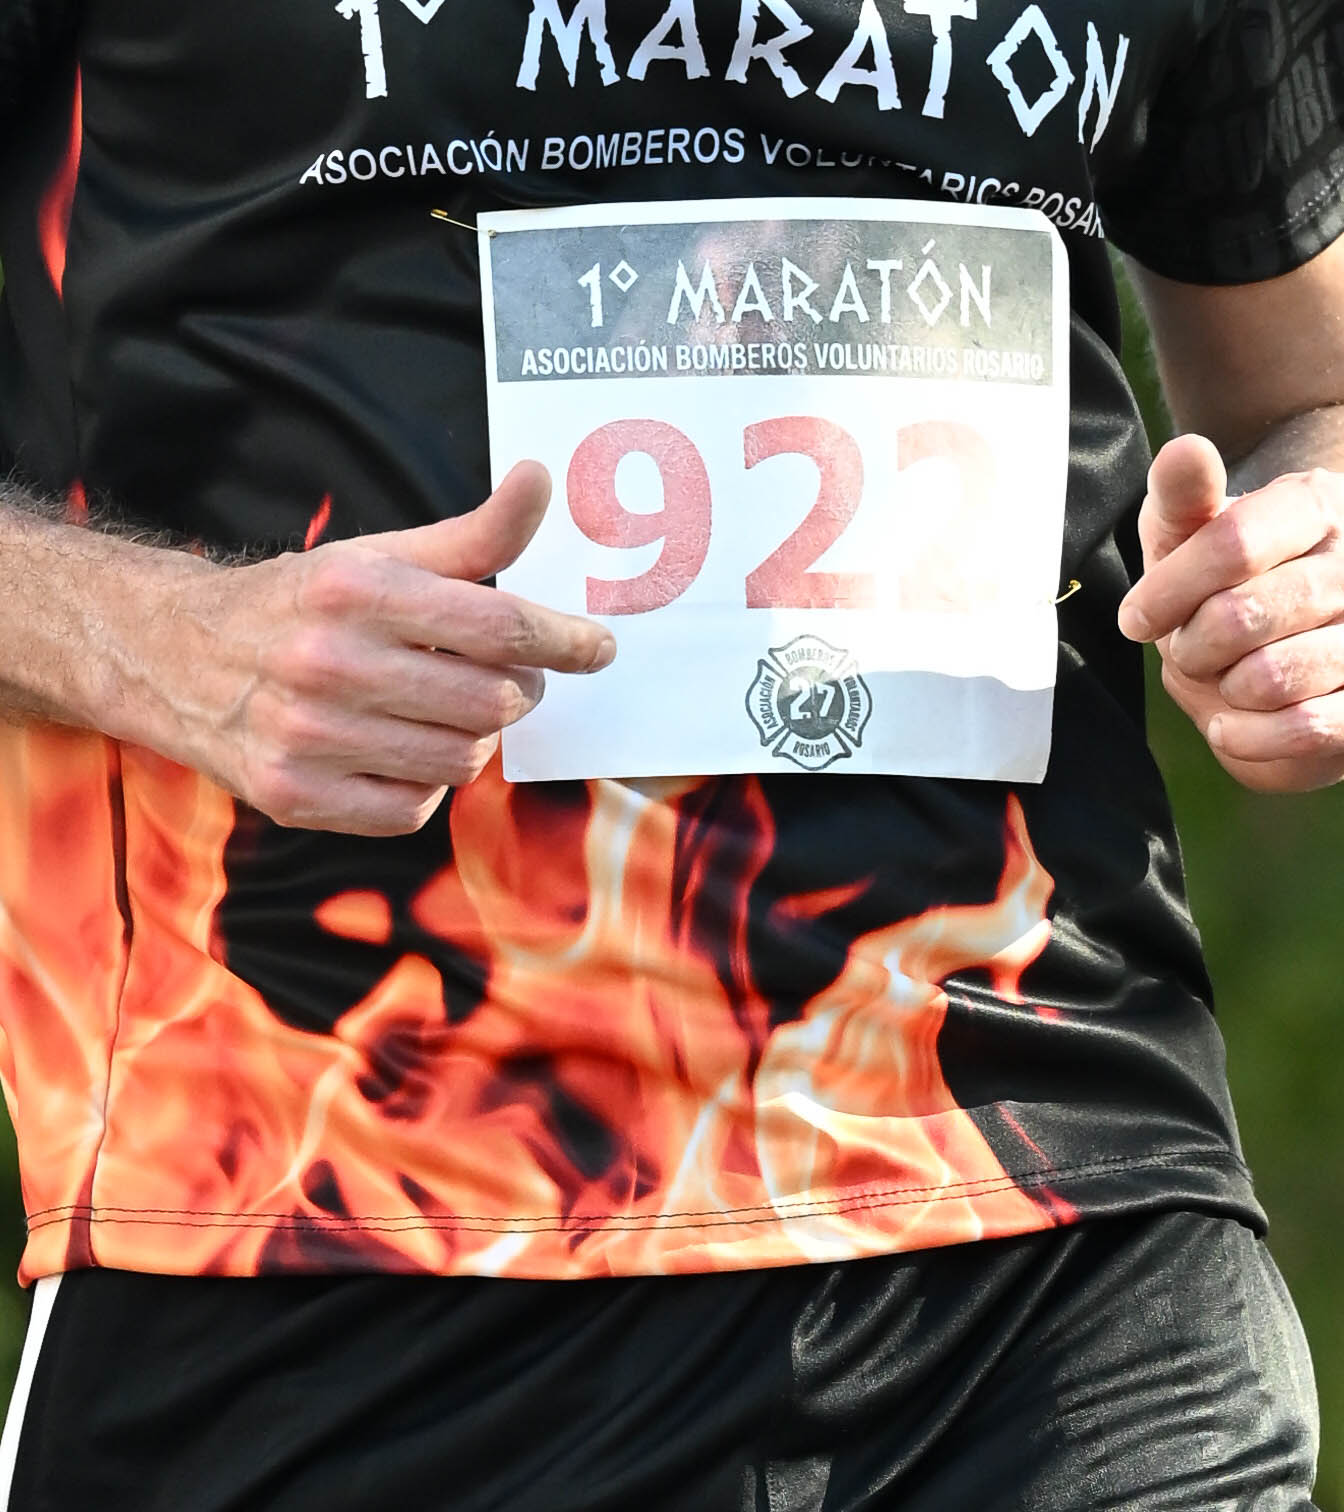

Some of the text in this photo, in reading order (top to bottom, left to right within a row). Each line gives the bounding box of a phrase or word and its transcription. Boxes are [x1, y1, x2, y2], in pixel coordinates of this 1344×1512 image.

[300, 130, 531, 187] ASOCIACIÓN
[542, 128, 746, 172] BOMBEROS
[578, 239, 992, 328] 1° MARATÓN
[521, 341, 1044, 380] ASOCIACIÓN BOMBEROS VOLUNTARIOS ROSARIO
[566, 415, 998, 617] 922
[759, 674, 780, 730] ASOCIACIÓN
[789, 675, 836, 720] 27
[843, 675, 862, 732] VOLUNTARIOS
[792, 741, 831, 757] ROSARIO
